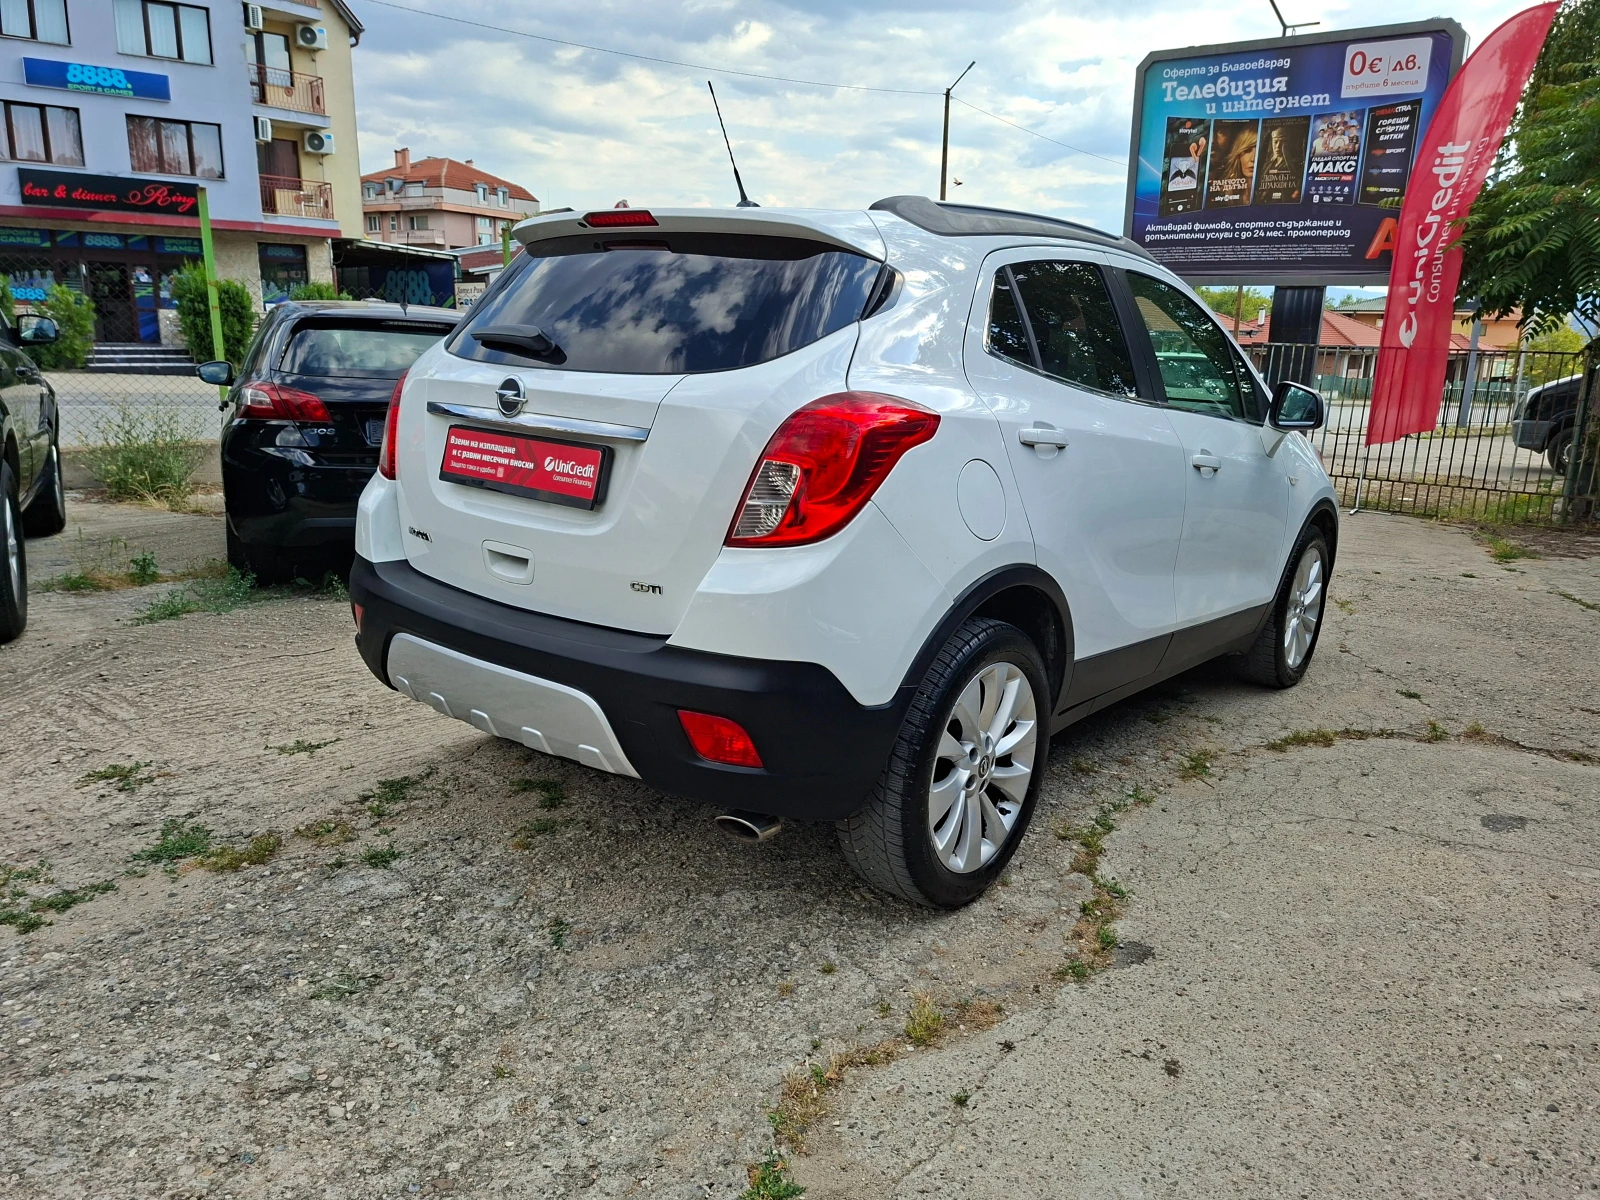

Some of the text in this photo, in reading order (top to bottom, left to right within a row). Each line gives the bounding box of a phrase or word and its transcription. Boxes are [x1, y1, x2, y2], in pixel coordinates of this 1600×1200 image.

[1163, 57, 1291, 79] Оферта за Благоевград
[1392, 54, 1422, 72] лв.
[67, 83, 95, 92] SPORT
[104, 88, 134, 97] GAMES
[1162, 76, 1288, 102] Телевизия
[1345, 78, 1419, 91] първите 6 месеца
[1206, 92, 1331, 114] и интернет
[1378, 116, 1410, 126] ГОРЕЩИ
[1379, 133, 1404, 141] БИТКИ
[1308, 161, 1357, 174] МАКС
[1212, 178, 1246, 187] РАНЧОТО
[1259, 181, 1297, 190] ДРАКОНА
[23, 182, 197, 213] bar & dinner Ring
[1145, 221, 1192, 232] Активирай
[1193, 221, 1233, 232] филмово,
[1235, 219, 1274, 230] спортно
[1275, 218, 1335, 229] съдържание
[0, 236, 41, 244] GAMES
[163, 238, 191, 246] SPORT
[1144, 231, 1205, 242] допълнителни
[1206, 231, 1234, 241] услуги
[1240, 230, 1252, 240] до
[1253, 229, 1265, 238] 24
[1287, 229, 1351, 238] промопериод
[164, 244, 200, 252] GAMES
[1427, 219, 1452, 303] Consumer
[450, 435, 470, 447] Вземи
[479, 441, 516, 455] изплащане
[450, 460, 467, 470] Защото
[452, 448, 457, 456] и
[461, 451, 482, 460] равни
[482, 454, 509, 465] месечни
[510, 460, 534, 470] вноски
[554, 458, 595, 478] UniCredit
[553, 474, 592, 489] Consumer Financing
